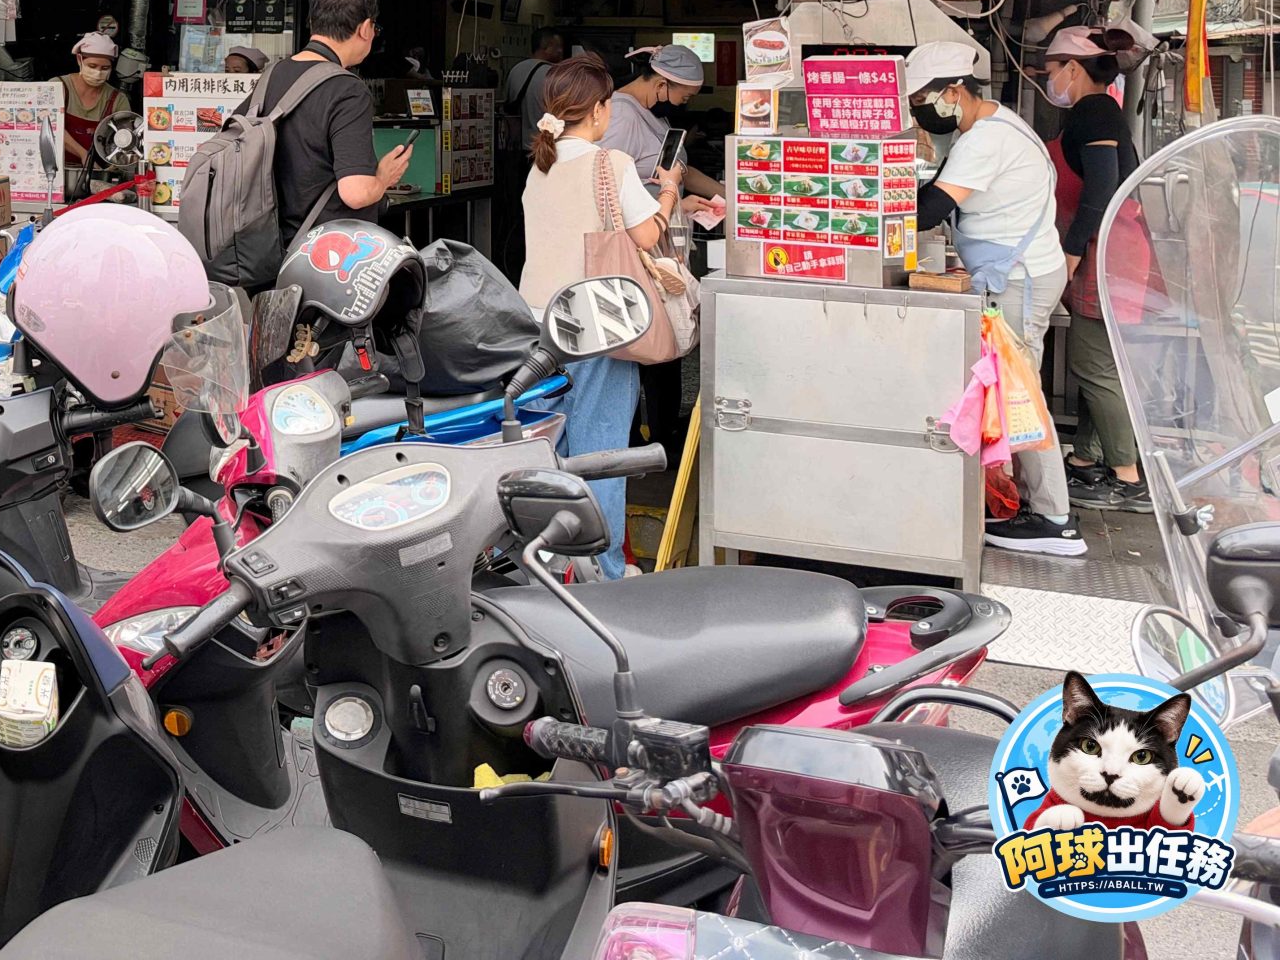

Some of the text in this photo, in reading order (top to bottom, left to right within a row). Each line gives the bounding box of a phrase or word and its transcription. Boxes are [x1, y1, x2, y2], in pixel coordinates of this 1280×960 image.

[812, 98, 895, 109] 使用全支付或載具
[804, 250, 813, 260] 請
[777, 255, 845, 274] 勿自己動手拿蒜頭
